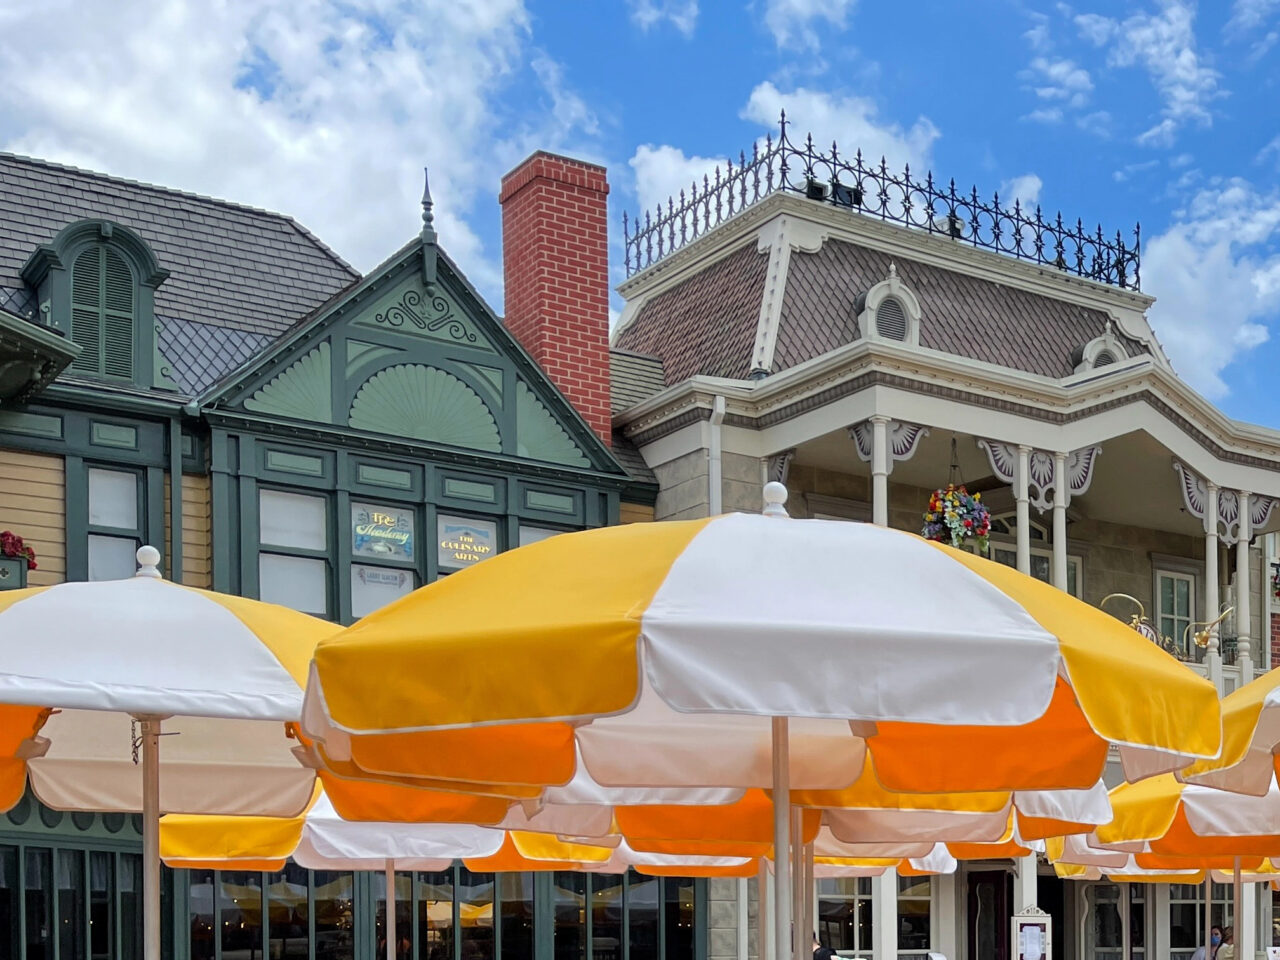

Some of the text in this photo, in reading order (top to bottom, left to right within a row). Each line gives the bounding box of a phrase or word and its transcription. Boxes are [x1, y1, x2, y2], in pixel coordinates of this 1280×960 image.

[356, 524, 409, 545] Academy
[441, 541, 491, 553] CULINARY
[453, 552, 480, 561] ARTS
